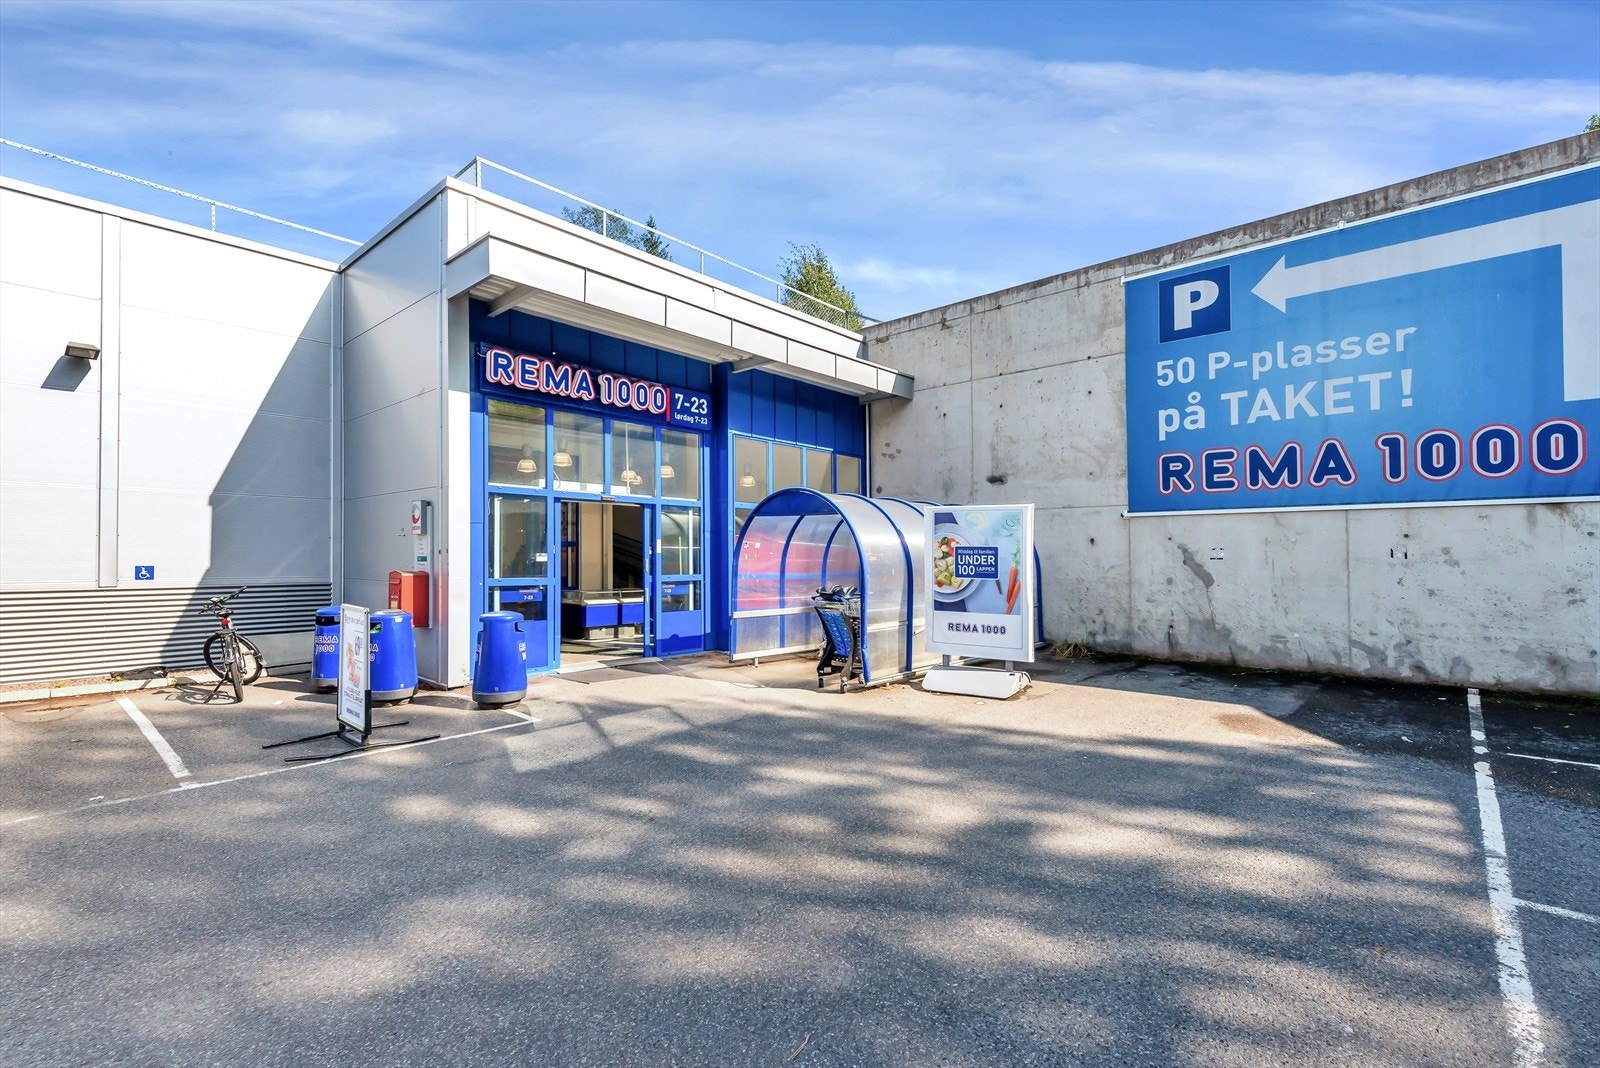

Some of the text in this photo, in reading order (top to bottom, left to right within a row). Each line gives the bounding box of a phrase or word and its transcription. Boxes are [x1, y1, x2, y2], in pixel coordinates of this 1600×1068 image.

[1173, 279, 1220, 332] P
[1156, 326, 1418, 387] 50 P-plasser
[486, 348, 668, 415] REMA 1000
[674, 393, 708, 415] 7-23
[674, 412, 708, 425] lørdag 7-23
[1158, 368, 1414, 442] på TAKET!
[1158, 417, 1587, 496] REMA 1000
[958, 555, 995, 565] UNDER
[958, 565, 975, 575] 100
[947, 622, 1007, 635] REMA 1000
